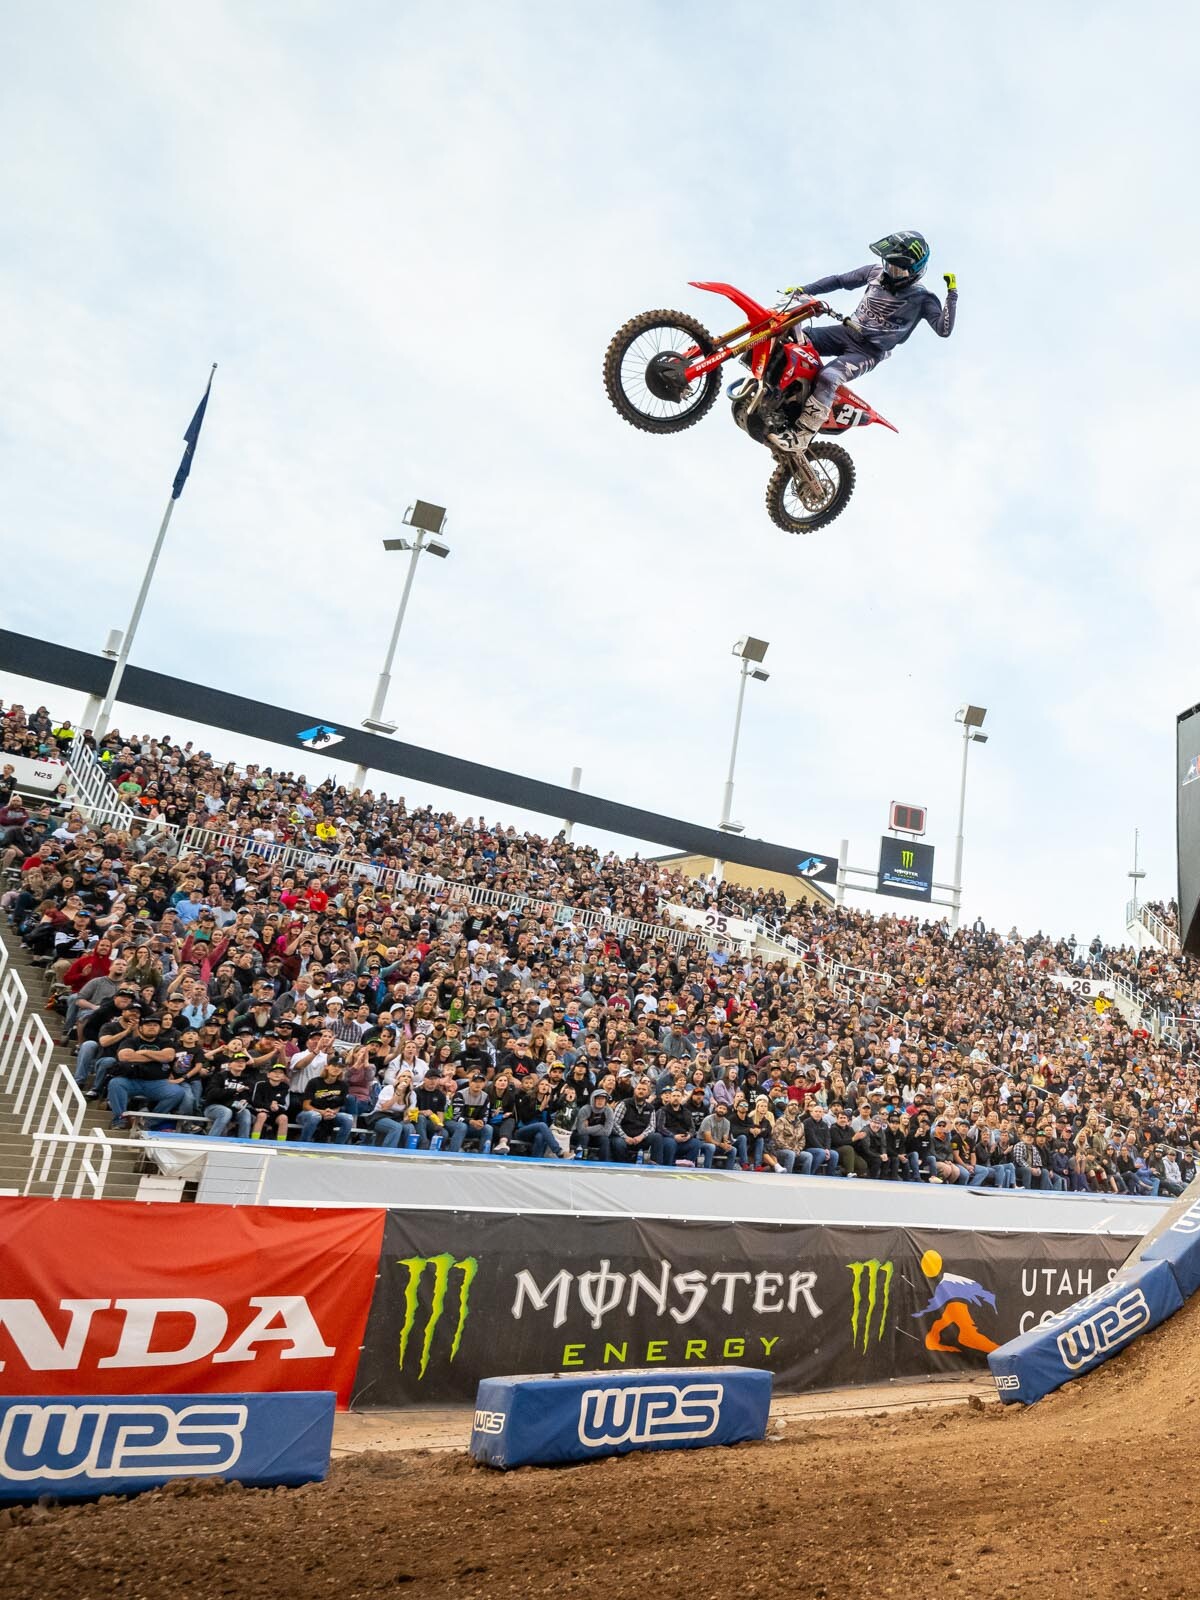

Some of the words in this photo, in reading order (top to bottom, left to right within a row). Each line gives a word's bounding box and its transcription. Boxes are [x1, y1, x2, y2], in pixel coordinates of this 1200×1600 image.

[696, 351, 727, 372] DUNLOP
[836, 403, 863, 427] 21
[34, 771, 53, 780] N25
[705, 915, 728, 933] 25
[1072, 980, 1091, 995] 26
[511, 1258, 822, 1330] MONSTER
[1021, 1268, 1093, 1297] UTAH
[1056, 1288, 1151, 1370] WPS
[562, 1336, 780, 1366] ENERGY
[473, 1410, 505, 1435] WPS
[579, 1384, 724, 1448] WPS
[2, 1405, 248, 1480] WPS
